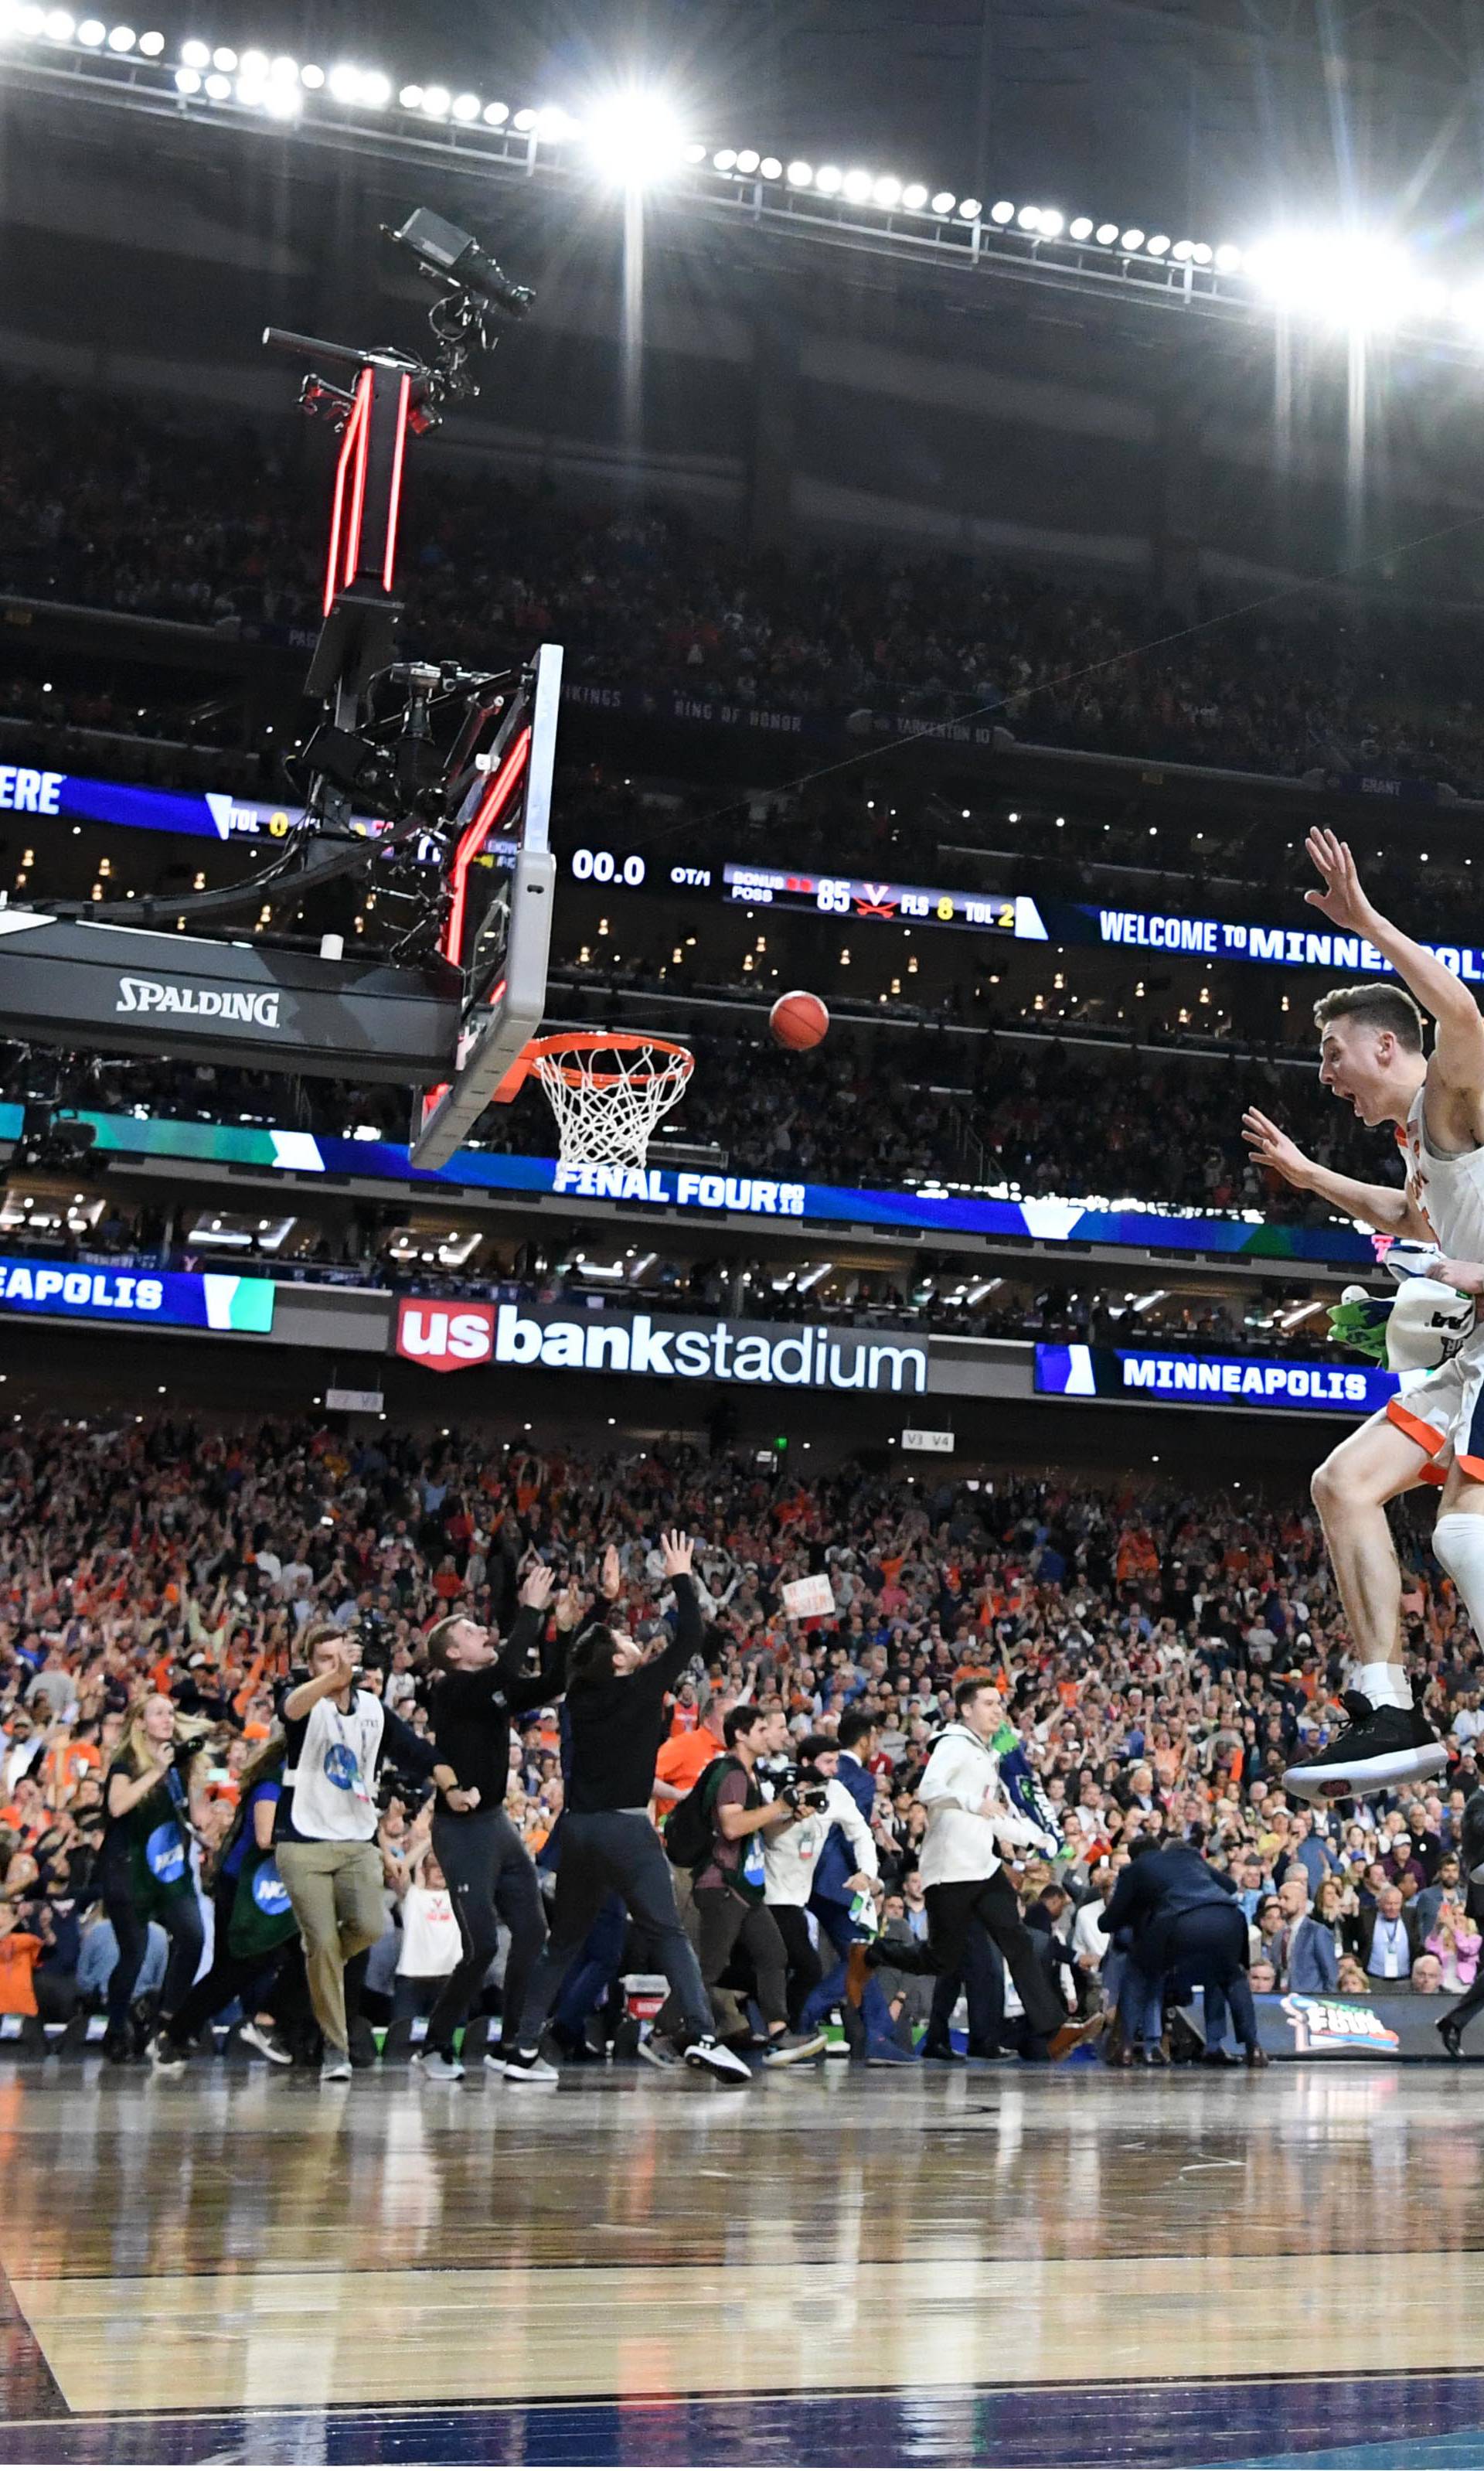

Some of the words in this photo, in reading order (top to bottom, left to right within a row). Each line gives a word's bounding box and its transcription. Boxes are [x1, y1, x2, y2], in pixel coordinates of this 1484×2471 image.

[561, 684, 621, 707] IKINGS
[674, 699, 712, 720] RING
[572, 849, 645, 885] 00.0
[816, 879, 850, 912] 85
[937, 896, 954, 920] 8
[965, 901, 994, 924] TOL
[998, 903, 1015, 927] 2
[1100, 910, 1217, 952] WELCOME
[1223, 925, 1247, 949] TO
[1250, 927, 1484, 982] MINNEOL
[116, 976, 280, 1028] SPALDING
[553, 1161, 669, 1202] FINAL
[677, 1173, 778, 1212] FOUR
[1123, 1358, 1367, 1401] MINNEAPOLIS
